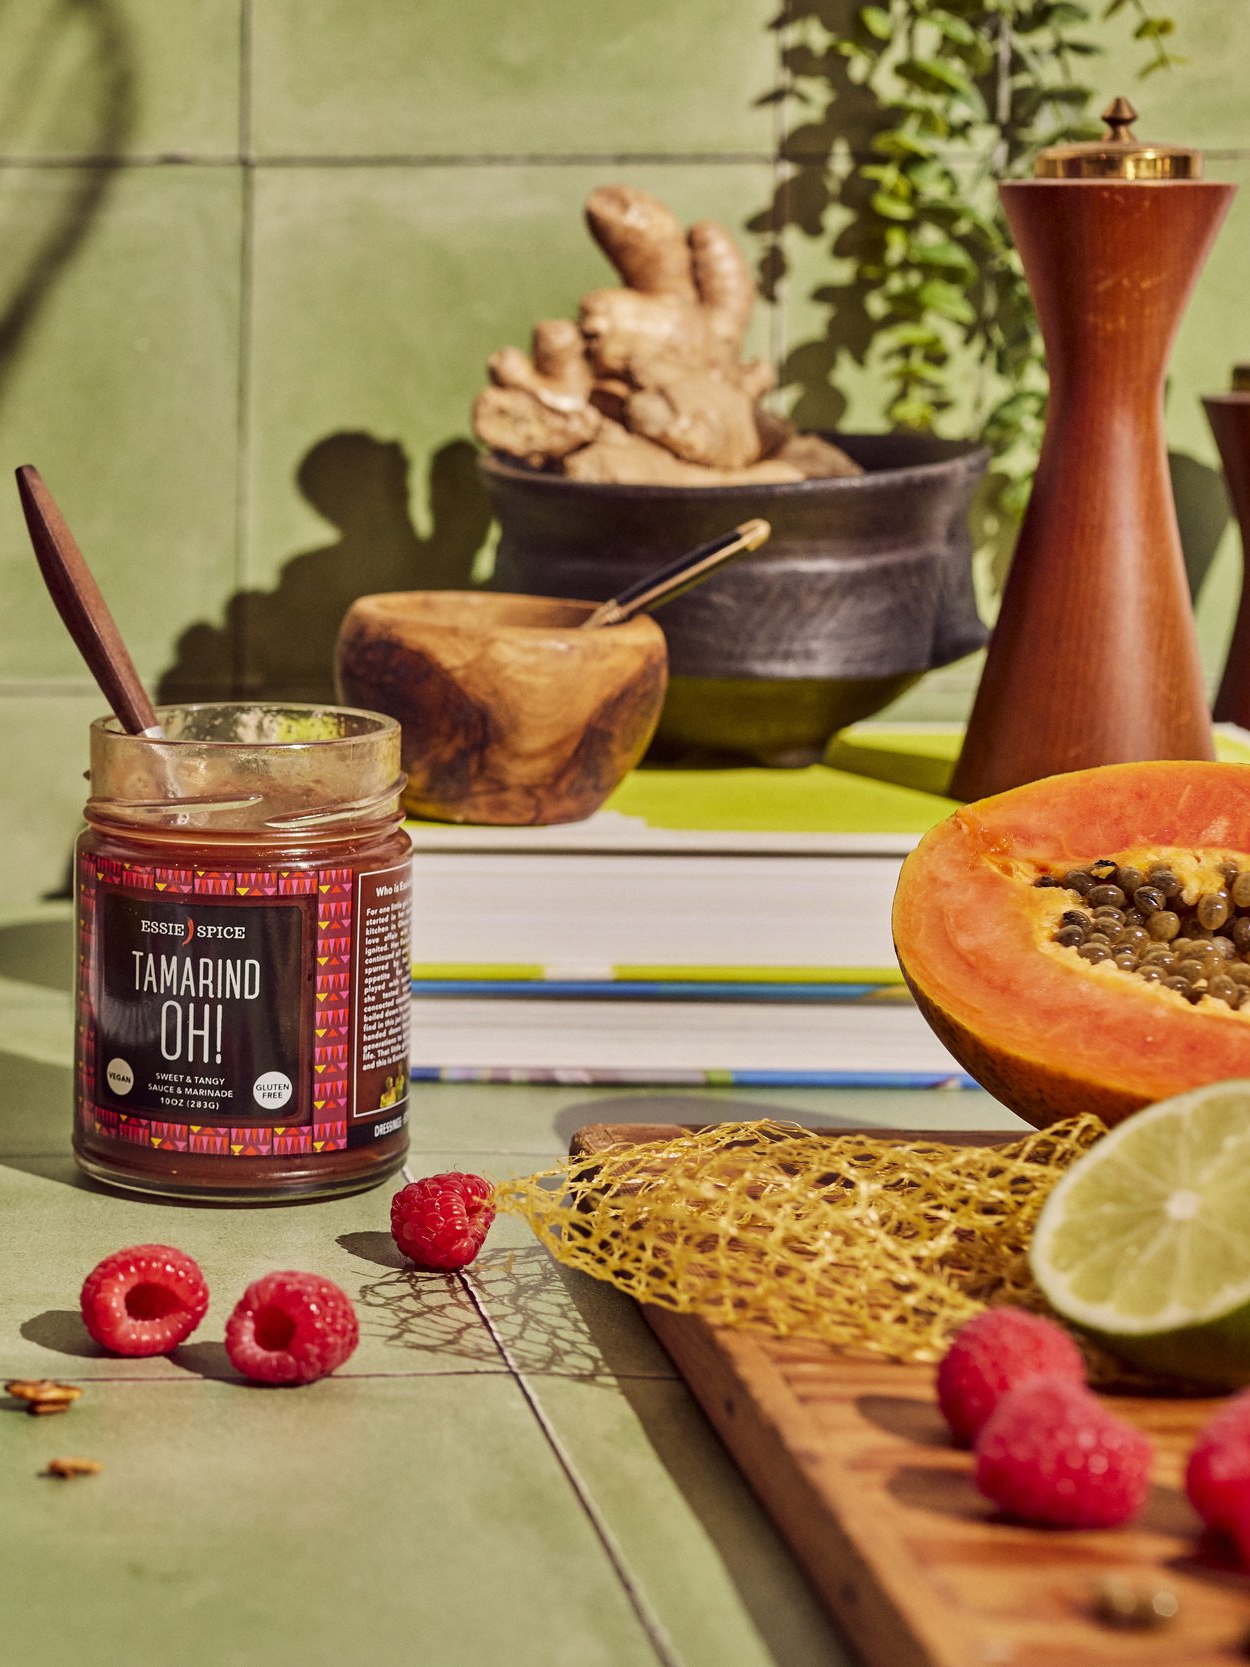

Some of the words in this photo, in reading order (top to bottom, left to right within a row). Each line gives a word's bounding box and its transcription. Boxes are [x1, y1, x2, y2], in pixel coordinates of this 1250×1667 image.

[376, 886, 393, 897] Who
[367, 908, 378, 916] For
[379, 906, 390, 914] one
[366, 915, 389, 926] started
[141, 920, 185, 936] ESSIE
[197, 926, 246, 939] SPICE
[366, 925, 389, 936] kitchen
[366, 937, 379, 945] love
[366, 944, 389, 956] ignited.
[365, 951, 394, 964] continued
[365, 962, 389, 975] spurred
[132, 951, 261, 1000] TAMARIND
[365, 972, 390, 985] appetite
[364, 982, 385, 995] played
[364, 996, 376, 1004] she
[364, 998, 394, 1012] concocted
[364, 1011, 384, 1023] boiled
[161, 1000, 222, 1065] OH!
[363, 1022, 377, 1032] find
[363, 1029, 387, 1042] handed
[363, 1037, 396, 1053] generations
[363, 1052, 376, 1061] life.
[377, 1048, 390, 1057] That
[363, 1060, 375, 1071] and
[376, 1058, 387, 1068] this
[108, 1072, 132, 1084] VEGAN
[156, 1072, 184, 1083] SWEET
[186, 1076, 192, 1084] &
[194, 1076, 226, 1086] TANGY
[148, 1083, 175, 1094] SAUCE
[176, 1087, 182, 1095] &
[184, 1088, 234, 1098] MARINADE
[256, 1083, 290, 1091] GLUTEN
[187, 1099, 220, 1111] (283G)
